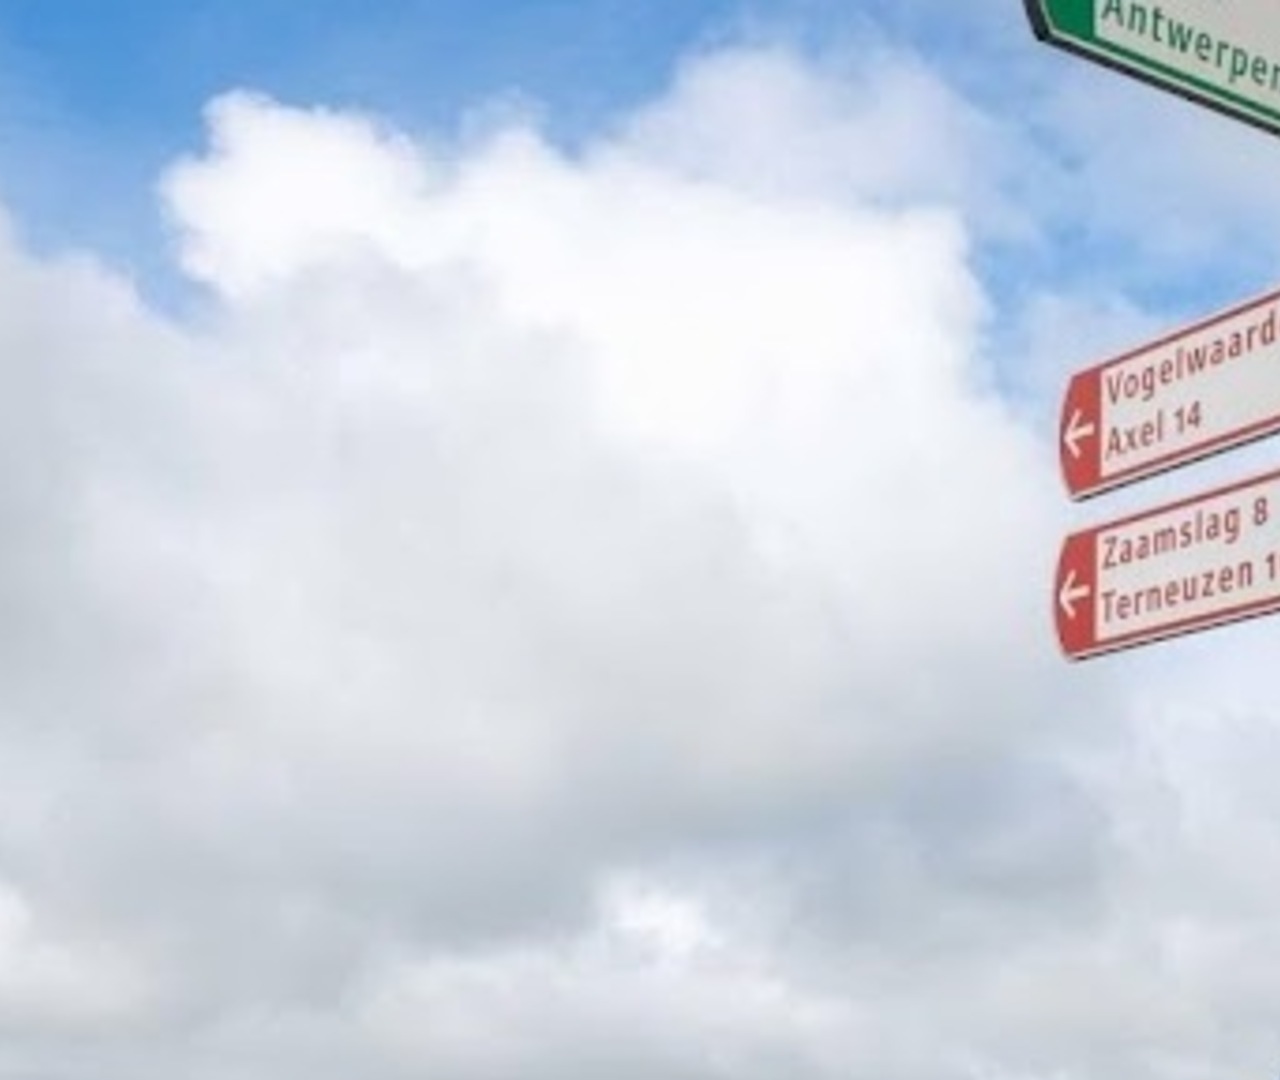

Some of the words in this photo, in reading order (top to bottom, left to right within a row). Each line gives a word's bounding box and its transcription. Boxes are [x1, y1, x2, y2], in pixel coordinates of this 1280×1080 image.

[1105, 410, 1165, 458] Axel
[1174, 400, 1202, 436] 14
[1103, 506, 1241, 569] Zaamslag
[1253, 497, 1269, 525] 8
[1100, 560, 1253, 624] Terneuzen
